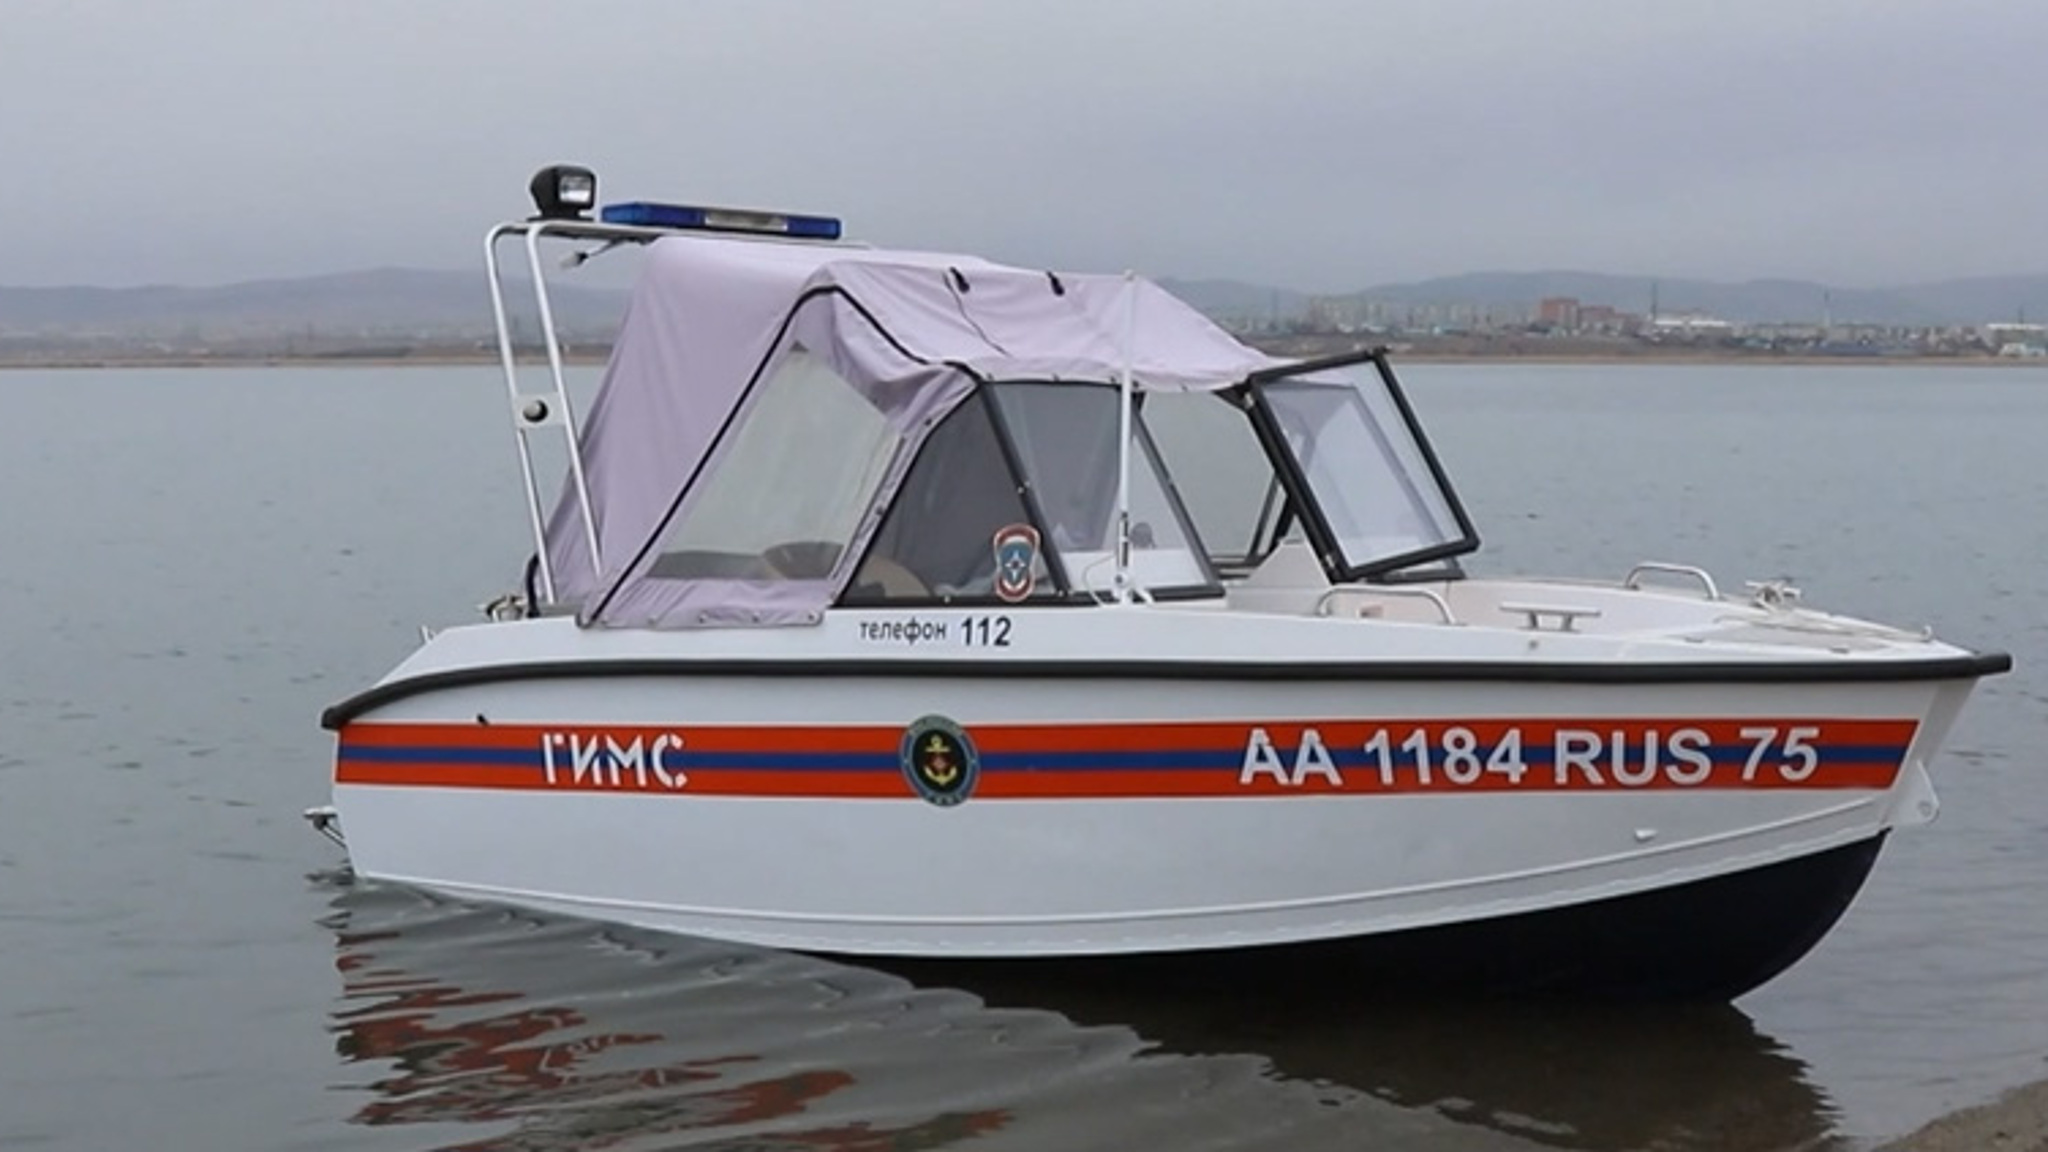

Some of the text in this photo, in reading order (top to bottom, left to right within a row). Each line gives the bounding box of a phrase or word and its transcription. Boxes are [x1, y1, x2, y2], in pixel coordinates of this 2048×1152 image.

[859, 615, 1012, 647] телефон 112
[541, 732, 688, 789] ГИМС
[1363, 727, 1528, 785] 1184
[1554, 729, 1713, 786] RUS
[1738, 727, 1820, 783] 75
